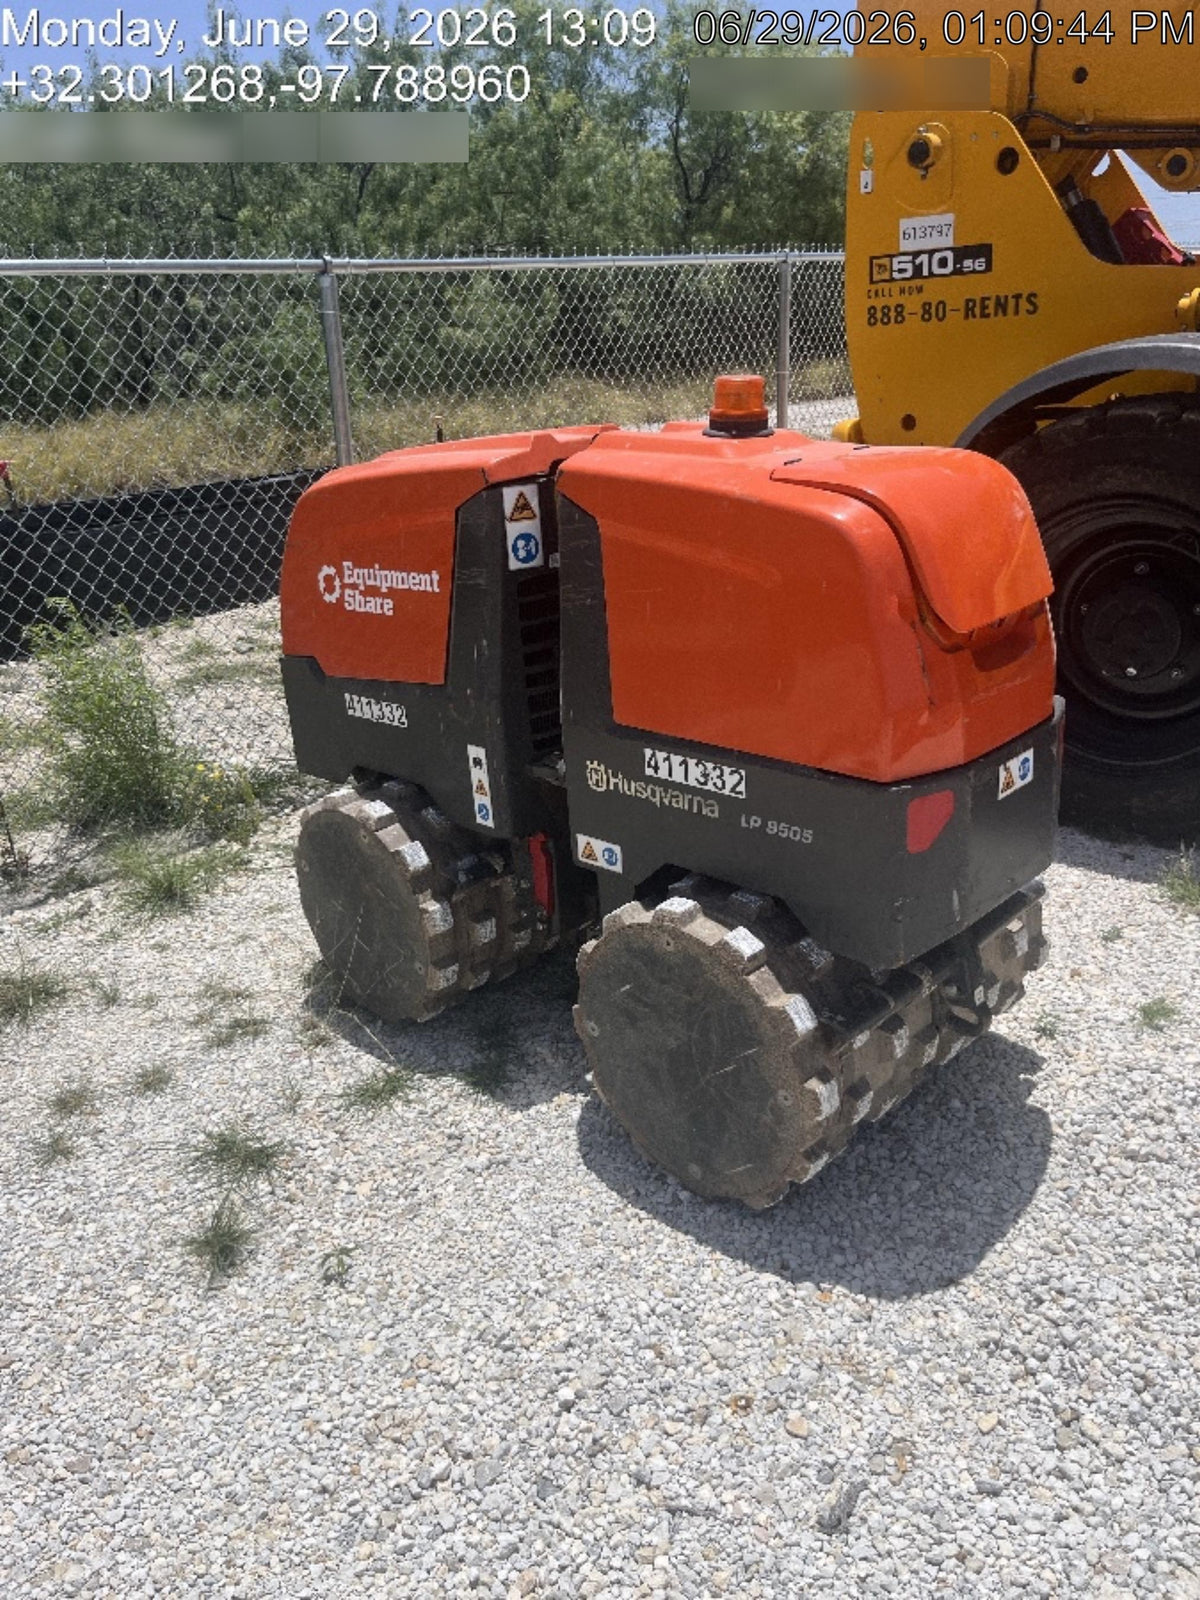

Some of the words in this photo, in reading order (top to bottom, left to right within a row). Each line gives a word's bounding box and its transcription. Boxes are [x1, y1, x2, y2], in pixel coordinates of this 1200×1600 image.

[902, 223, 953, 242] 613797
[866, 288, 894, 300] CALL
[899, 285, 925, 297] NOW
[867, 292, 1039, 326] 888-80-RENTS
[342, 561, 440, 592] Equipment
[344, 588, 394, 616] Share
[645, 749, 745, 797] 411332
[608, 768, 720, 818] Husqvarna
[741, 814, 762, 829] LP
[766, 820, 814, 844] 9505
